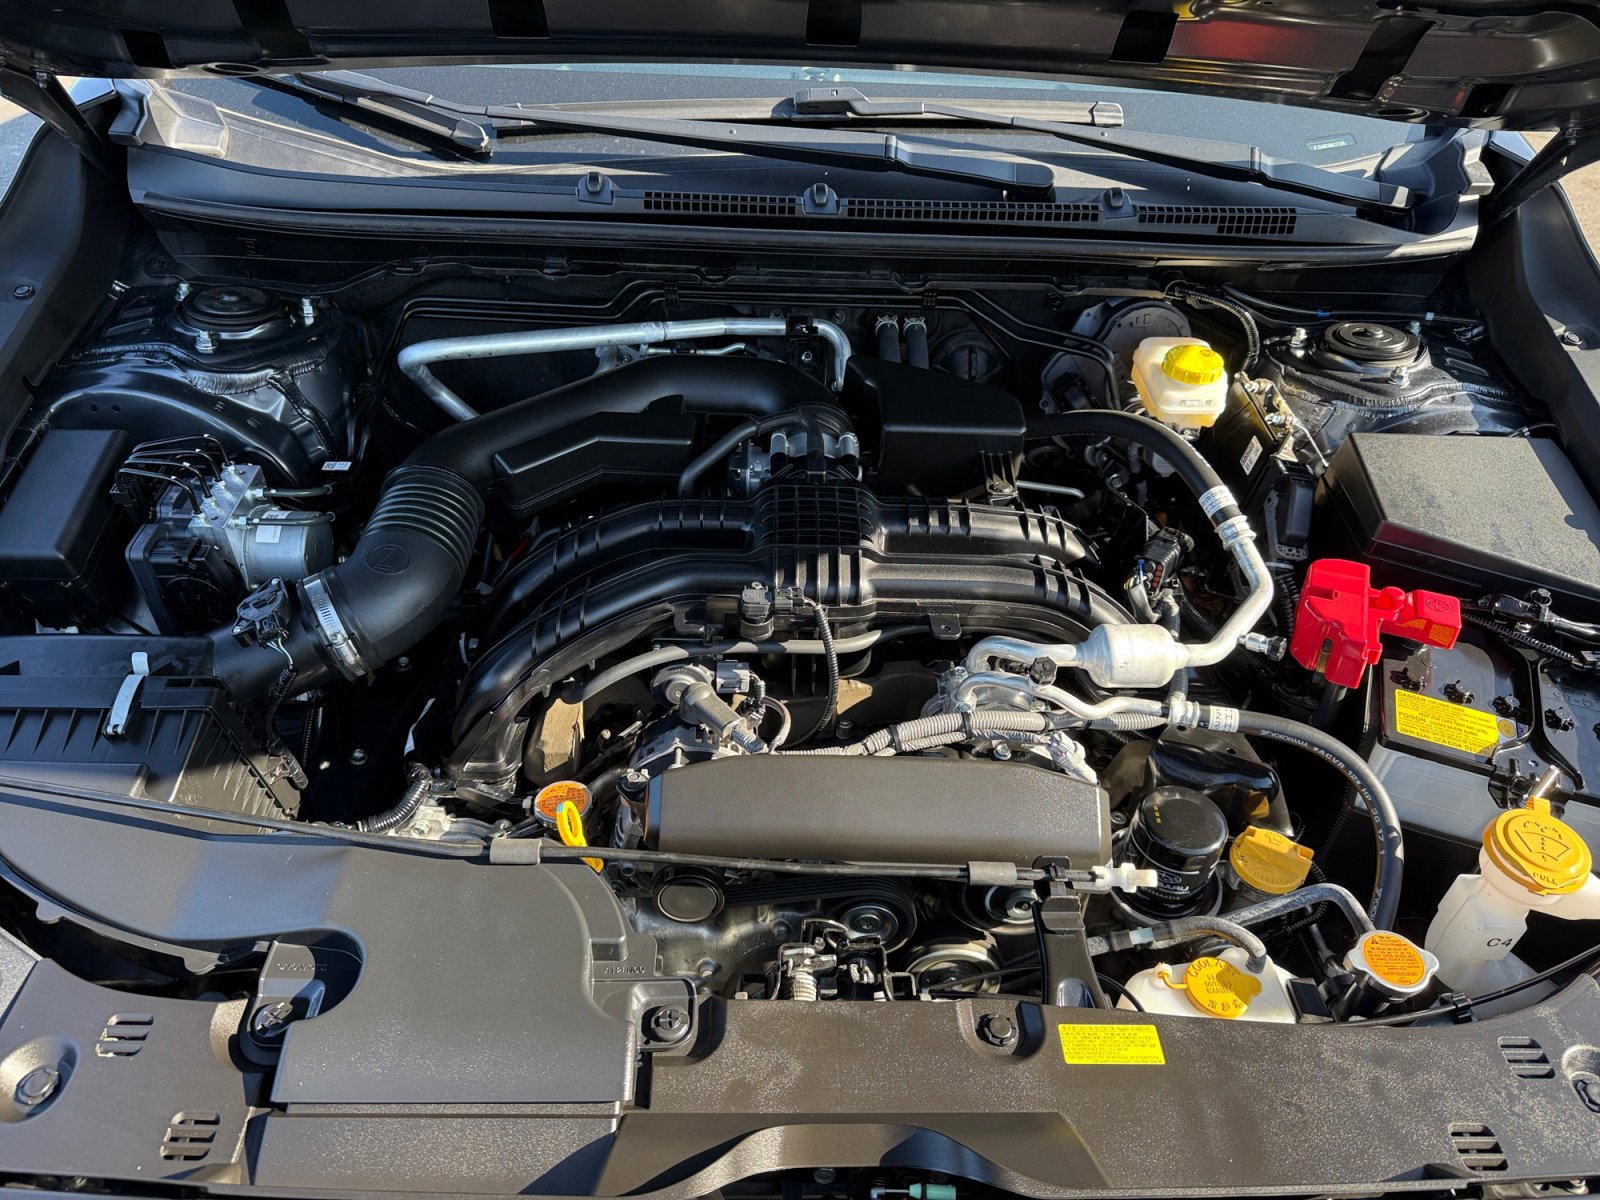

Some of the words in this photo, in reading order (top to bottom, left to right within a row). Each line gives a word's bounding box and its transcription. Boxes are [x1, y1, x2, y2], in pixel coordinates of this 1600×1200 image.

[1397, 690, 1425, 702] DANGER
[1398, 710, 1425, 722] POISON
[1270, 733, 1309, 748] YOKOHAMA
[1433, 736, 1446, 744] CCA
[1533, 872, 1558, 885] PULL
[1486, 938, 1512, 947] C4
